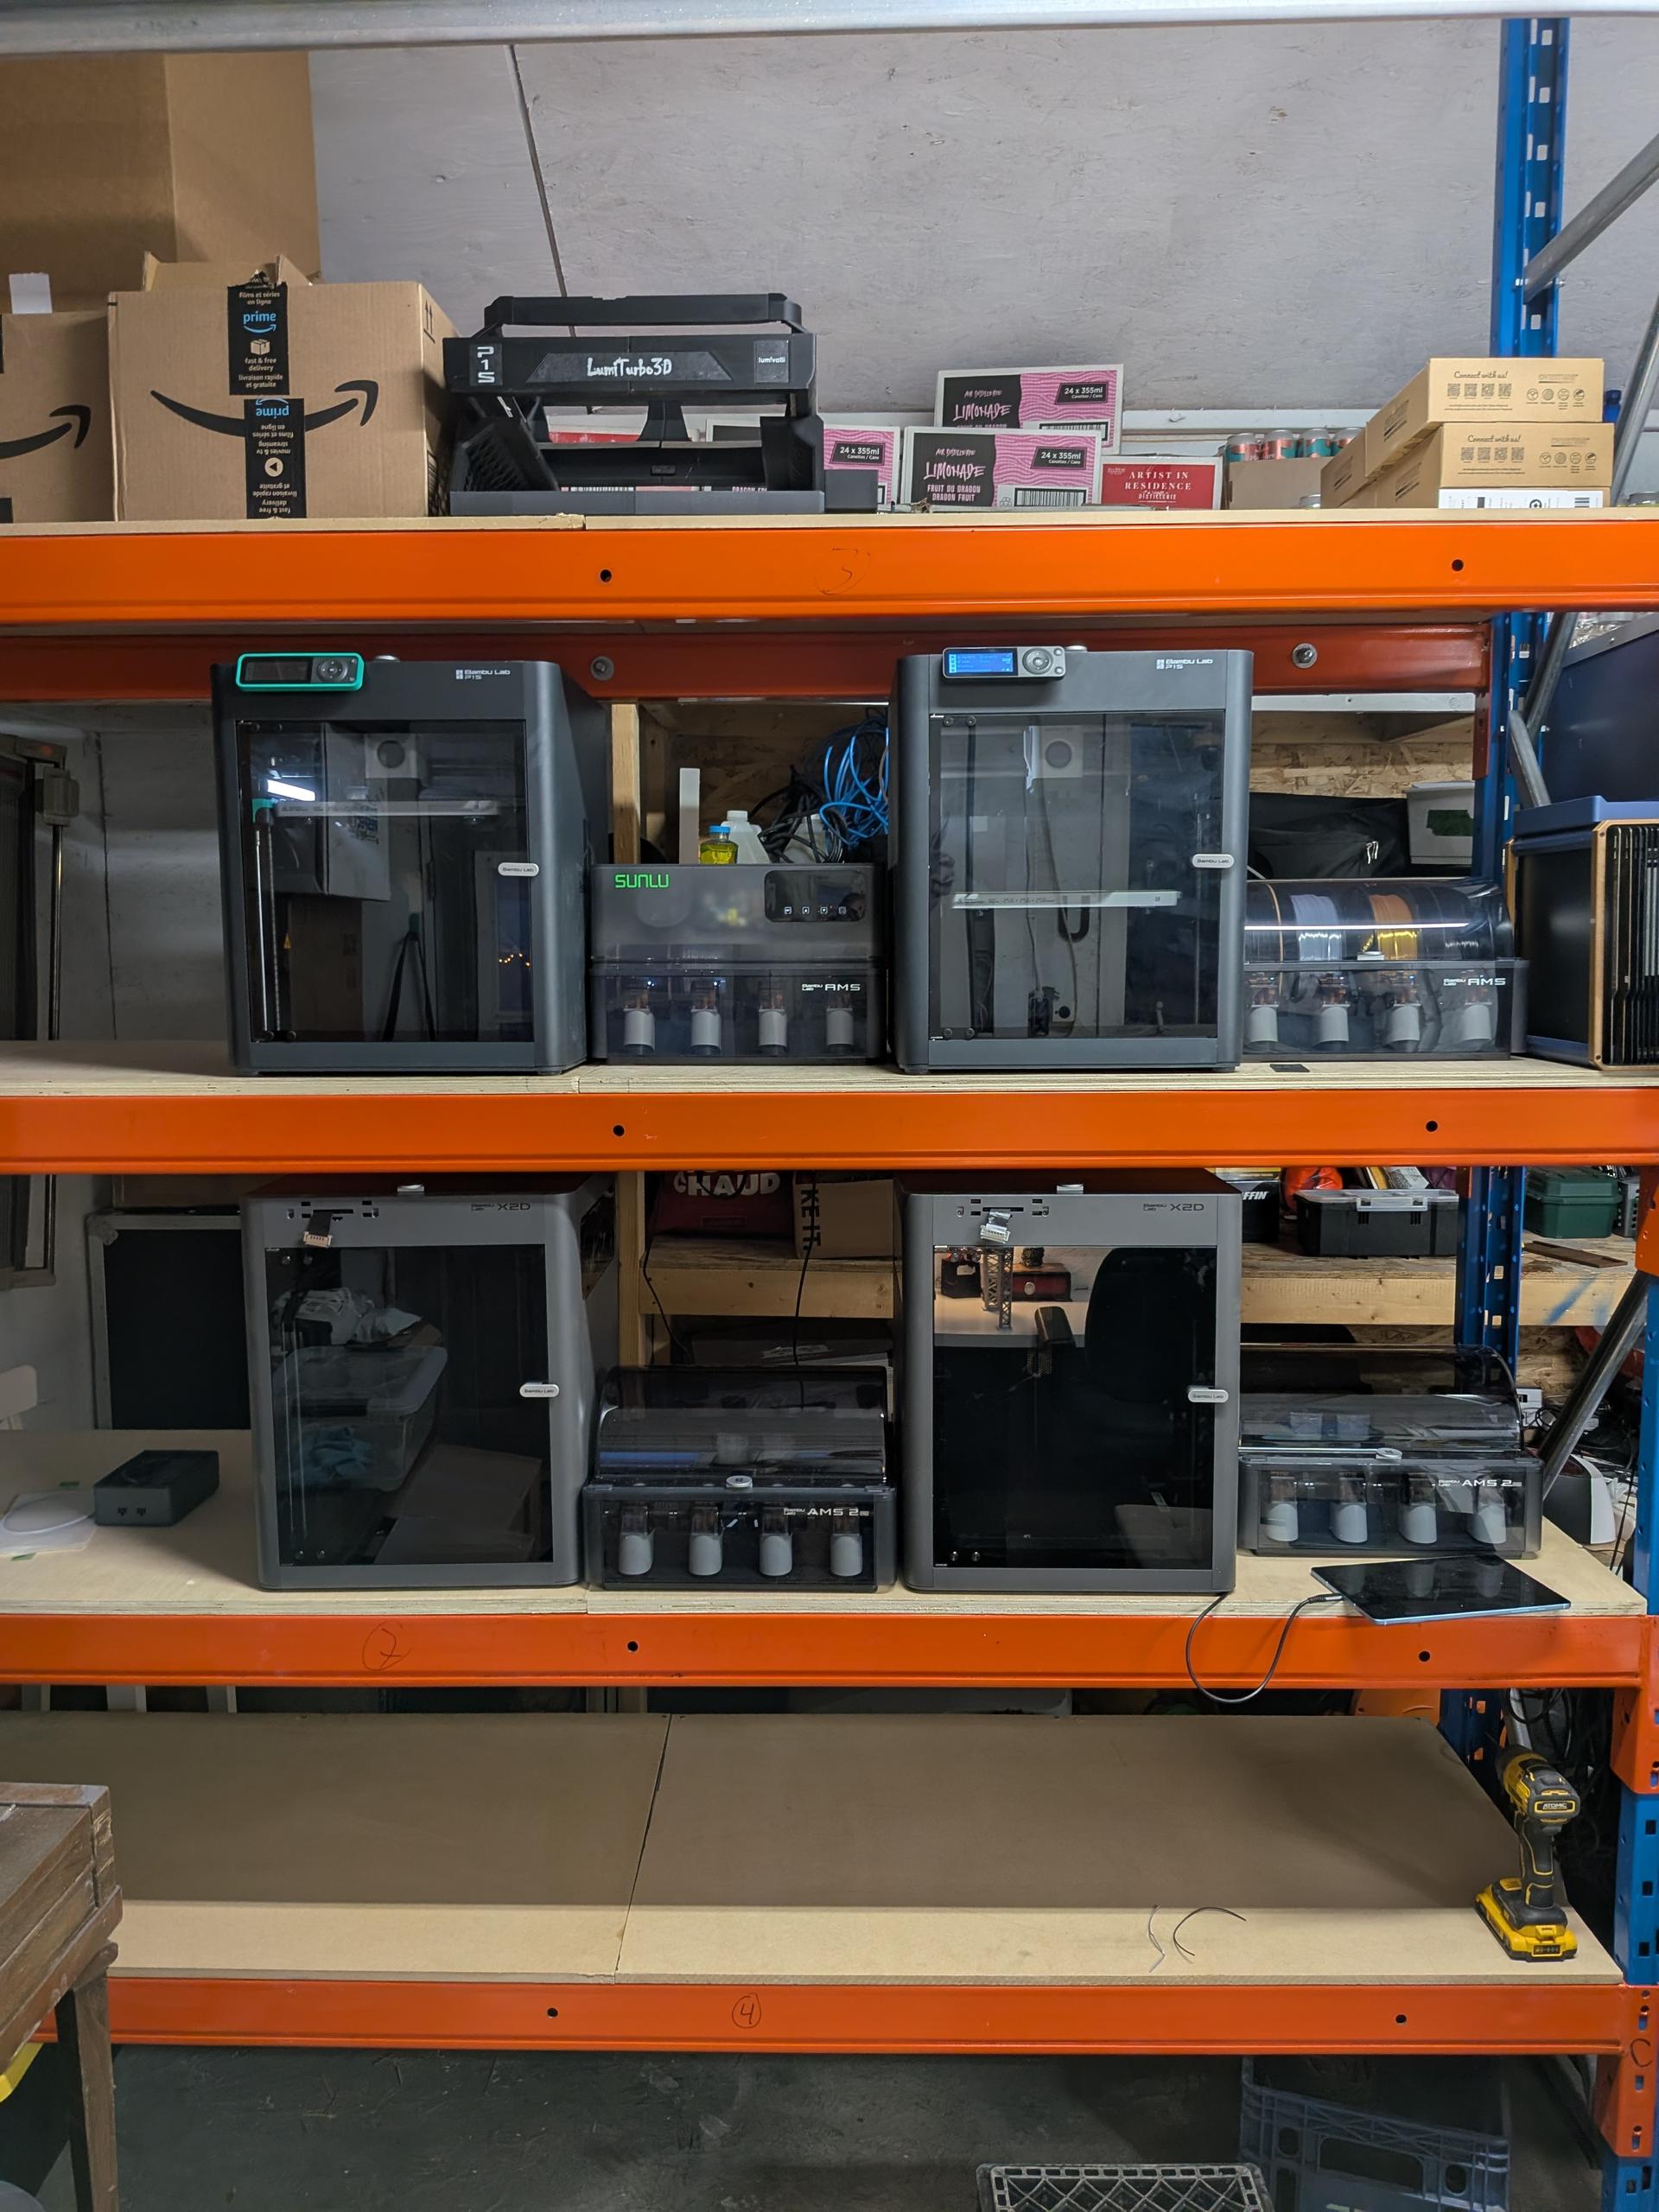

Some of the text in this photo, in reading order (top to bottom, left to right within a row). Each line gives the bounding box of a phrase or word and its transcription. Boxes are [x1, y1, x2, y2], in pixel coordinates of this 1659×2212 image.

[257, 298, 272, 307] ligne
[243, 311, 276, 325] prime
[587, 356, 672, 377] LumiTurbo3D
[1453, 370, 1481, 379] Connect
[1481, 370, 1497, 379] with
[255, 405, 289, 419] prime
[953, 403, 1012, 422] LIMONADE
[1466, 434, 1495, 443] Connect
[1495, 434, 1510, 443] with
[857, 447, 880, 455] 355ml
[923, 461, 986, 482] LIMONADE
[1128, 471, 1173, 480] ARTIST
[1176, 471, 1189, 480] IN
[927, 484, 982, 493] FRUIT DU DRAGON
[1124, 481, 1192, 491] RESIDENCE
[931, 493, 976, 502] DRAGON FRUIT
[1467, 977, 1506, 986] AMS
[674, 1172, 780, 1197] CHAUD
[1170, 1203, 1205, 1211] X2D
[807, 1508, 844, 1516] AMS
[849, 1508, 859, 1516] 2
[740, 2003, 754, 2024] 4
